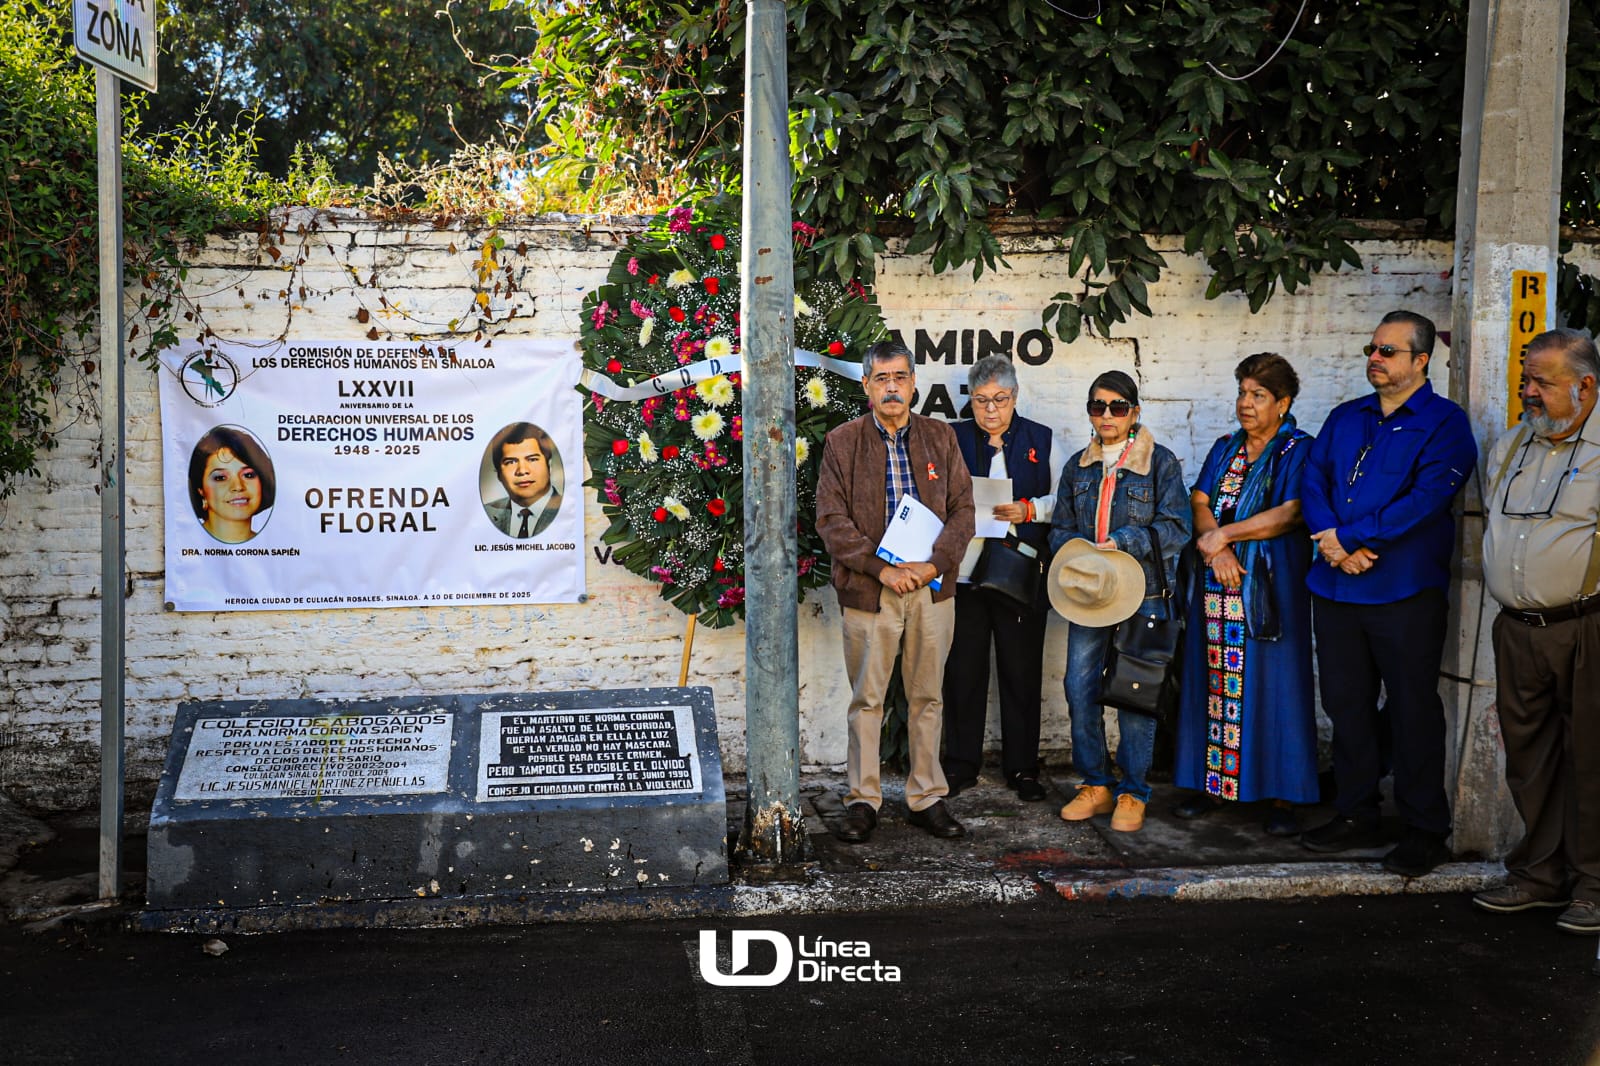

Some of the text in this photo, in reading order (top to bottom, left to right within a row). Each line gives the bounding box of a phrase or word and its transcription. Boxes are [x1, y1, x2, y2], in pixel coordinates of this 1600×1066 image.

[87, 2, 145, 68] ZONA
[289, 346, 352, 359] COMISIÓN
[357, 348, 374, 359] DE
[377, 348, 435, 359] DEFENSA
[252, 358, 495, 369] LOS DERECHOS HUMANOS EN SINALOA
[338, 380, 414, 397] LXXVII
[278, 414, 474, 425] DECLARACION UNIVERSAL DE LOS
[278, 426, 474, 442] DERECHOS HUMANOS
[334, 445, 369, 455] 1948
[385, 445, 420, 455] 2025
[305, 487, 450, 509] OFRENDA
[320, 511, 437, 533] FLORAL
[182, 547, 300, 556] DRA. NORMA CORONA SAPIÉN
[474, 542, 576, 552] LIC. JESÚS MICHEL JACOBO
[306, 595, 344, 604] CULIACÁN
[456, 592, 497, 600] DICIEMBRE
[201, 715, 447, 730] COLEGIO DE ABOGADOS
[513, 712, 665, 725] EL MARTIRIO DE NORMA CORONA
[222, 725, 424, 738] DRA. NORMA CORONA SAPIEN
[501, 726, 520, 735] FUE
[522, 725, 536, 735] UN
[539, 724, 576, 734] ASALTO
[580, 724, 594, 732] DE
[596, 723, 609, 732] LA
[275, 739, 326, 747] ESTADO
[350, 737, 412, 745] DERECHO
[506, 730, 670, 745] QUERIAN APAGAR EN ELLA LA LUZ
[195, 749, 259, 757] RESPETO
[262, 748, 271, 756] A
[273, 747, 300, 755] LOS
[303, 746, 374, 754] DERECHOS
[512, 740, 672, 754] DE LA VERDAD NO HAY MASCARA
[255, 755, 382, 765] DECIMO ANIVERSARIO
[527, 753, 566, 763] POSIBLE
[569, 753, 593, 762] PARA
[597, 752, 625, 761] ESTE
[225, 765, 282, 773] CONSEJO
[283, 762, 344, 771] DIRECTIVO
[349, 769, 365, 777] DEL
[488, 759, 685, 777] PERO TAMPOCO ES POSIBLE EL OLVIDO
[617, 770, 690, 781] 2 DE JUNIO 1990
[223, 780, 262, 791] JESUS
[262, 779, 305, 790] MANUEL
[310, 778, 364, 789] MARTINEZ
[488, 779, 693, 796] CONSEJO CIUDADANO CONTRA LA VIOLENCIA
[280, 788, 345, 796] PRESIDENTE
